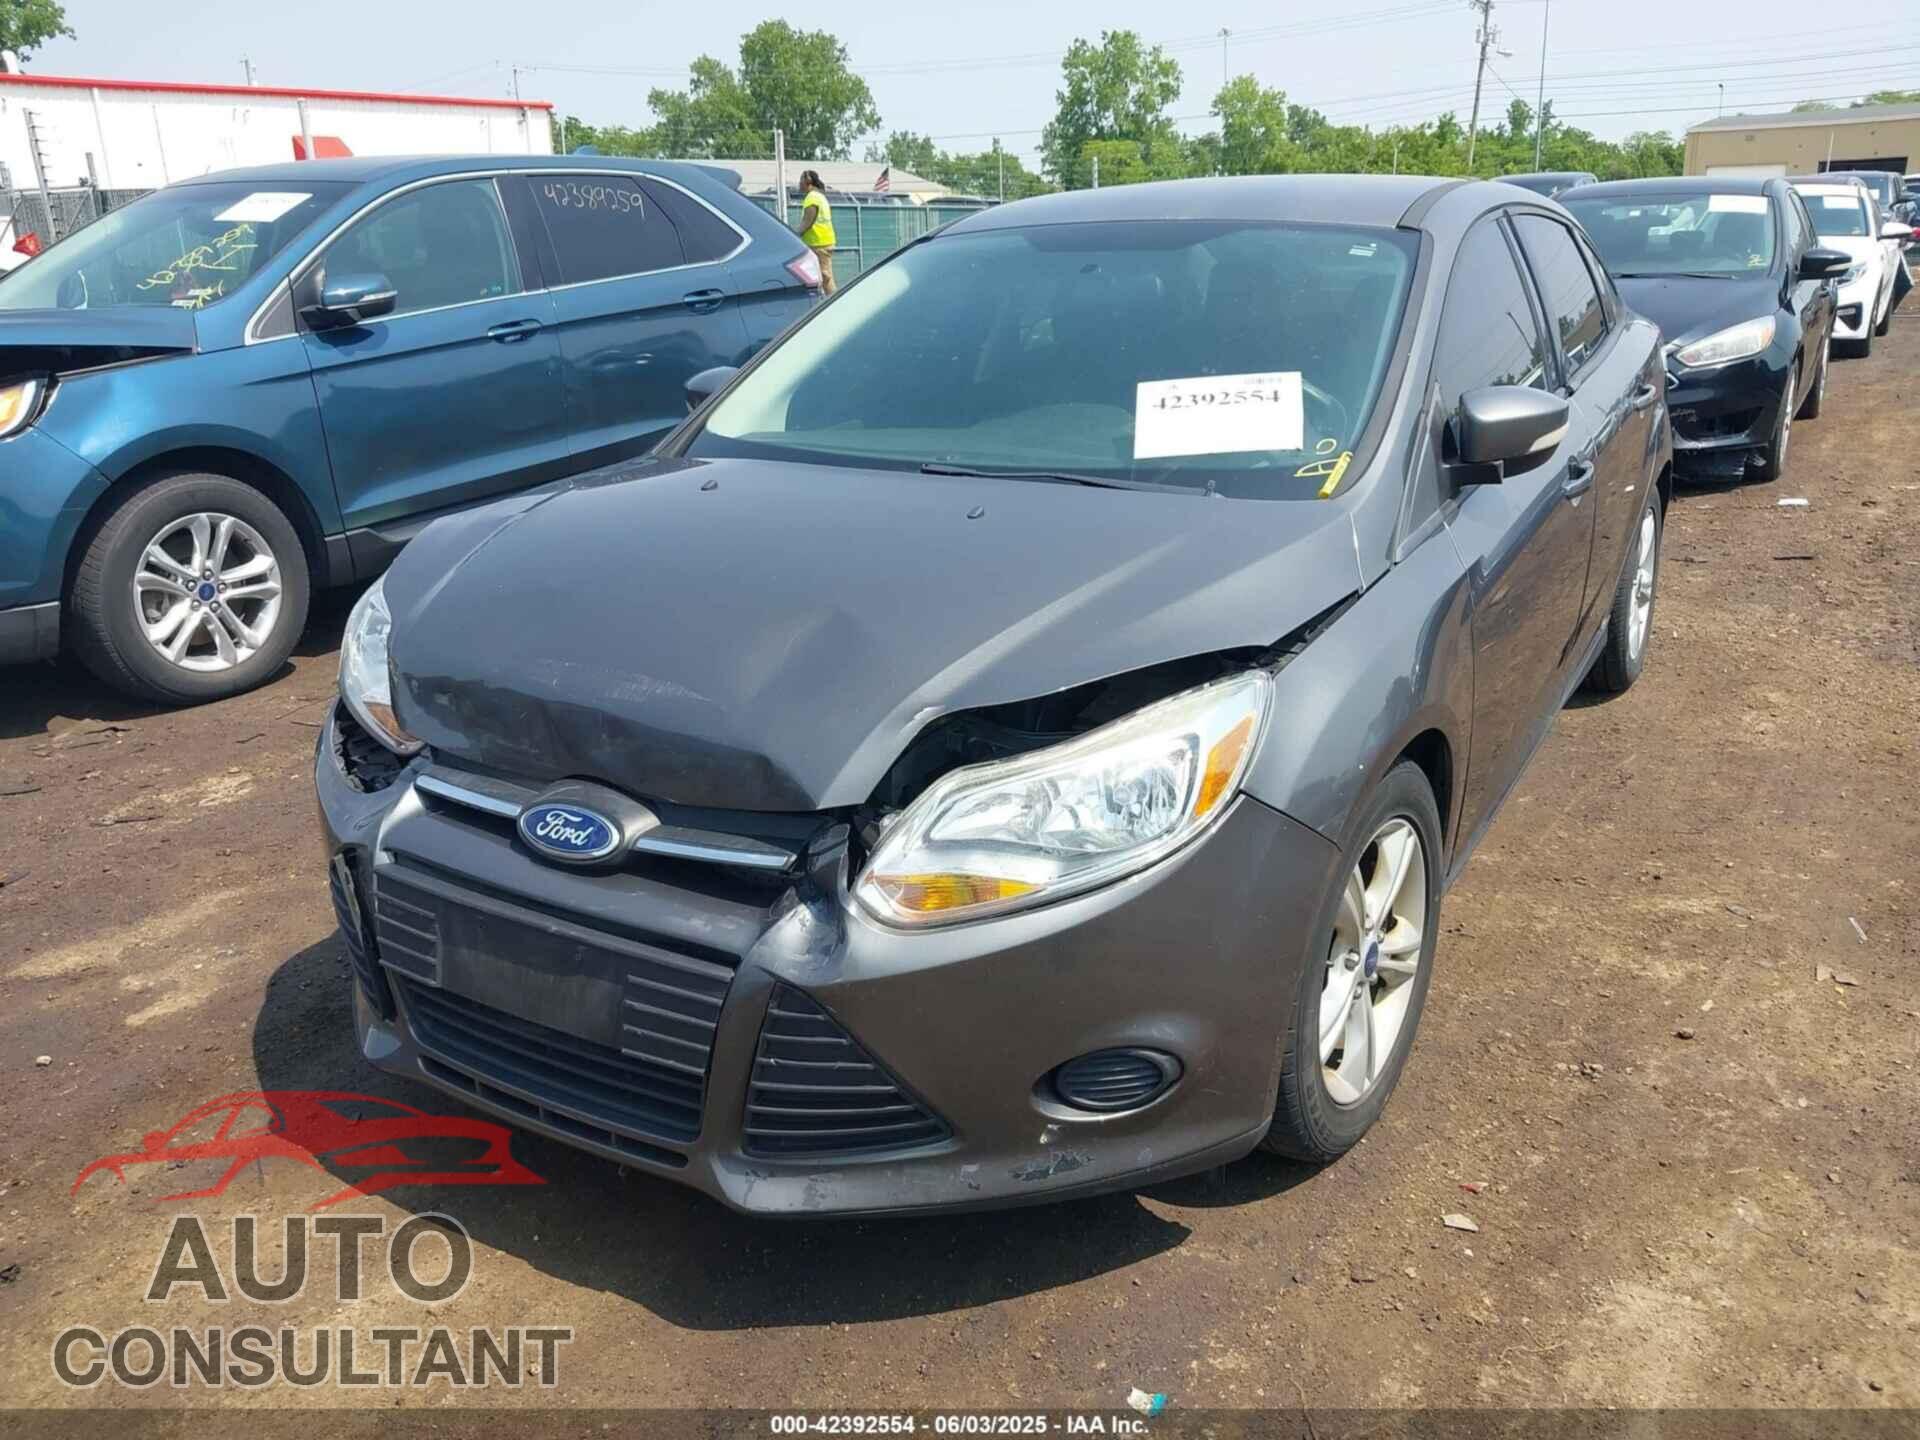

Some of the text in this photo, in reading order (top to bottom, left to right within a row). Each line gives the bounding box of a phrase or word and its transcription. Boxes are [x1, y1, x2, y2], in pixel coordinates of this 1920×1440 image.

[543, 182, 646, 221] 42389259
[1151, 389, 1281, 411] 42392554
[535, 809, 595, 847] Ford
